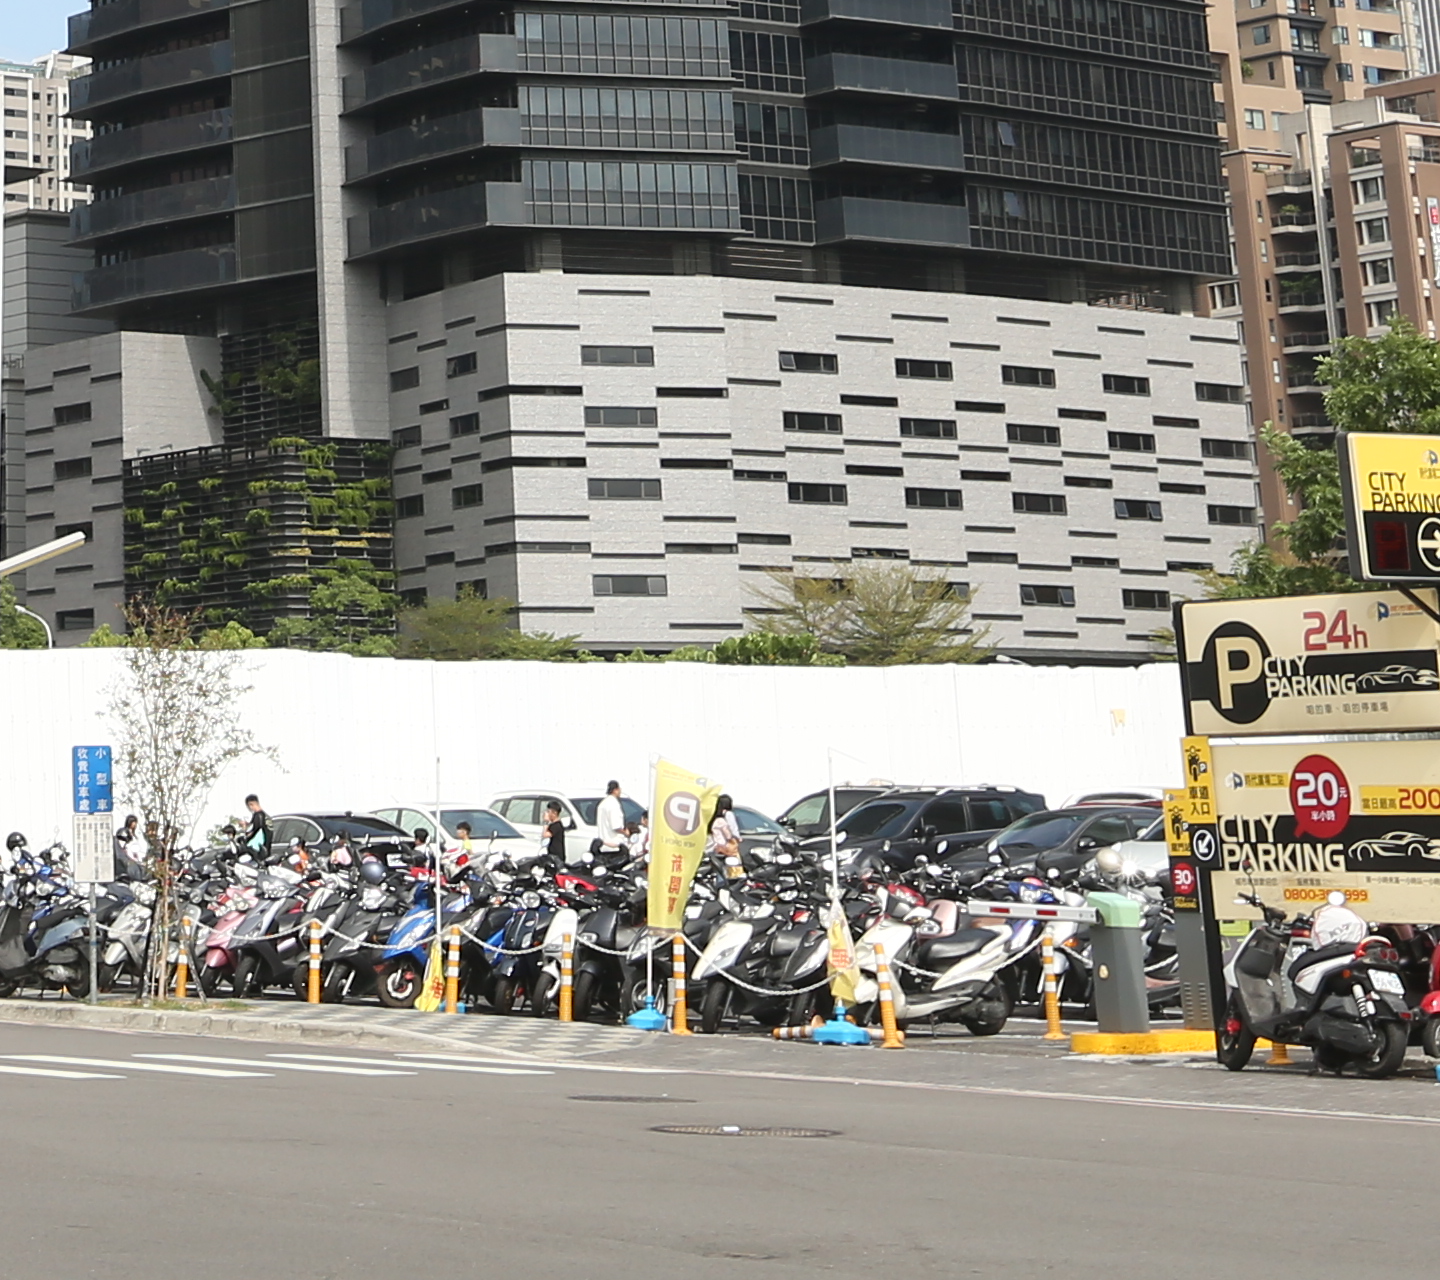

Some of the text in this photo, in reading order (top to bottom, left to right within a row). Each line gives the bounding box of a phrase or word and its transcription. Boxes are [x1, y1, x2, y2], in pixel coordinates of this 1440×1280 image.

[1368, 472, 1406, 491] CITY
[1303, 609, 1369, 651] 24h
[1215, 636, 1264, 710] P
[1264, 655, 1308, 678] CITY
[1266, 673, 1357, 699] PARKING
[94, 747, 109, 811] 小型車
[1295, 772, 1339, 807] 20
[1189, 786, 1210, 800] 車道
[1191, 801, 1212, 816] 入口
[1219, 814, 1279, 843] CITY
[1222, 842, 1346, 873] PARKING
[1174, 869, 1193, 885] 30
[1284, 888, 1368, 901] 0800-3999
